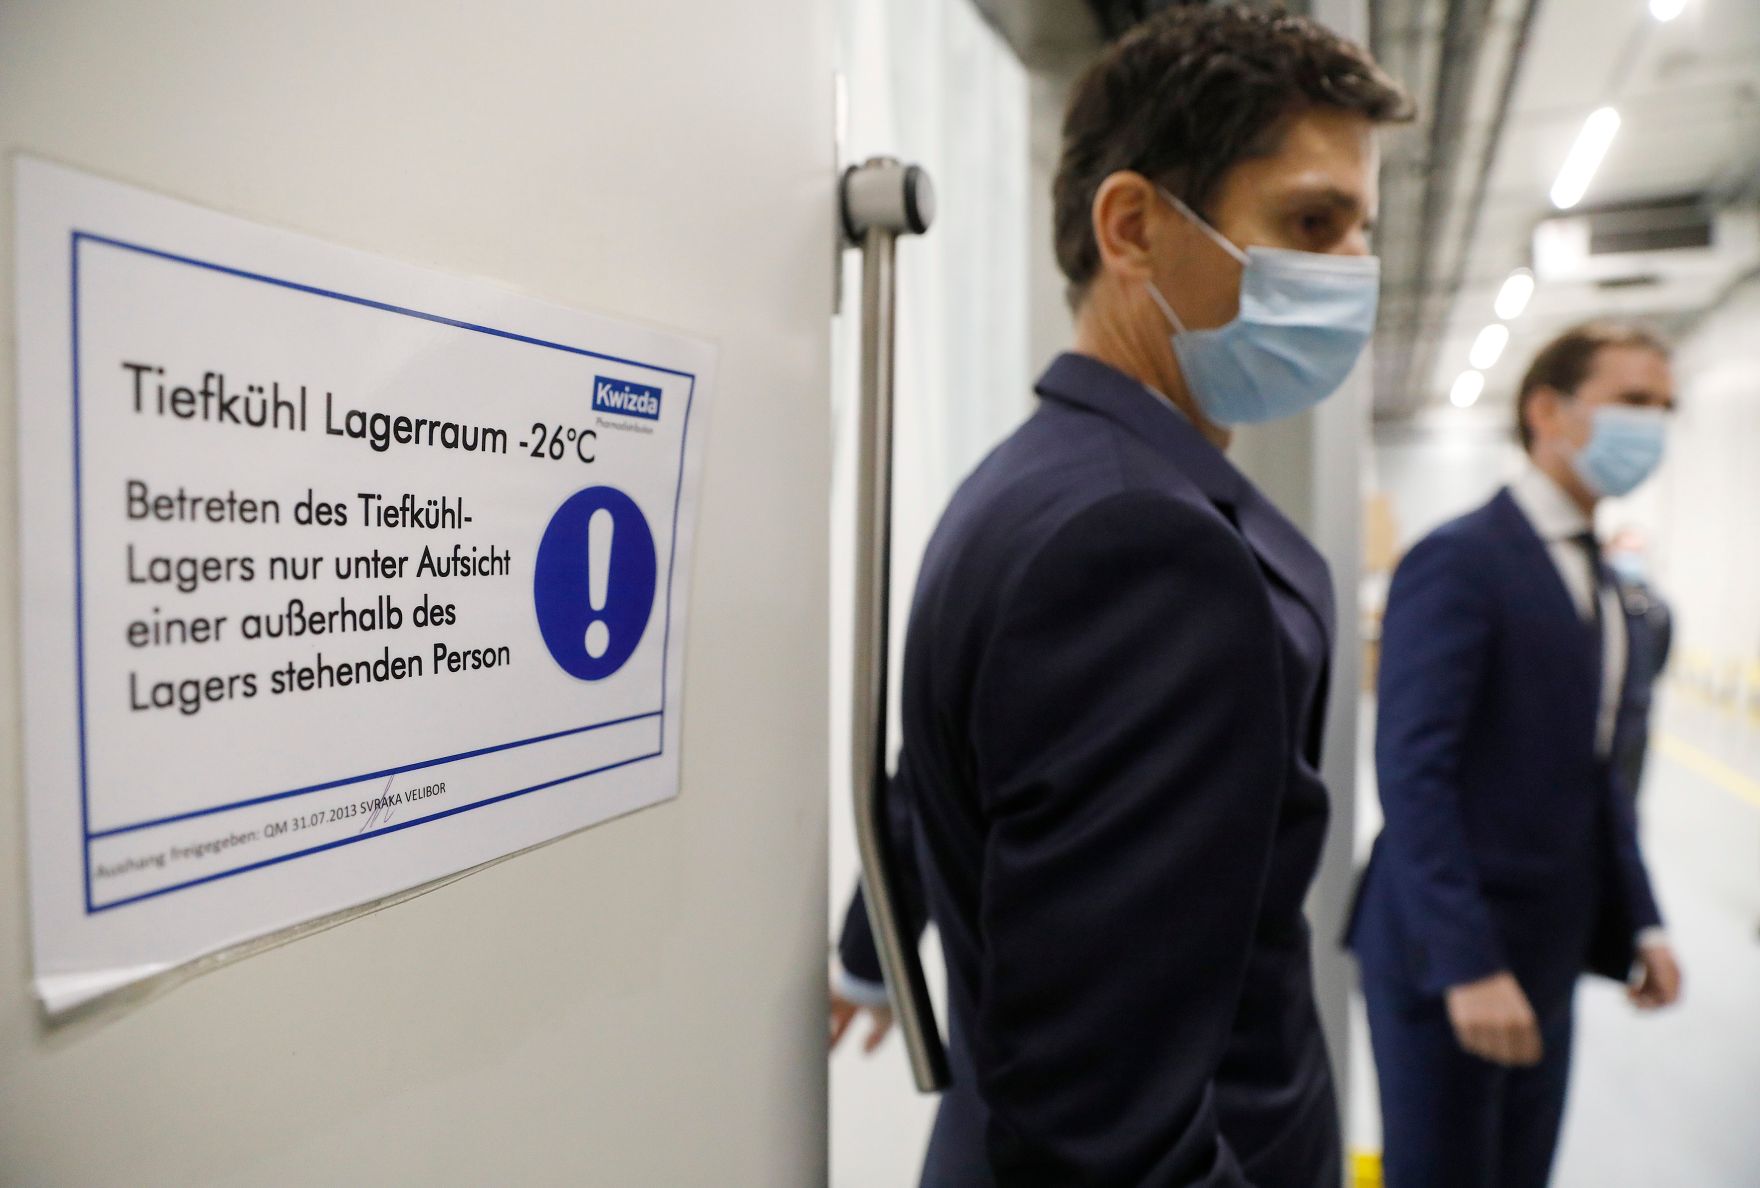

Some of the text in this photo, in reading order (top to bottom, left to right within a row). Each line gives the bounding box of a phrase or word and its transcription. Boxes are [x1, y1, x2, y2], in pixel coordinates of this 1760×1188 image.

[121, 361, 597, 464] Tiefkühl Lagerraum -26°C
[596, 382, 659, 415] Kwizda
[125, 479, 473, 530] Betreten des Tiefkühl-
[126, 543, 511, 595] Lagers nur unter Aufsicht
[126, 593, 457, 649] einer außerhalb des
[129, 642, 511, 717] Lagers stehenden Person
[264, 820, 289, 839] QM
[291, 804, 358, 832] 31.07.2013
[360, 793, 403, 815] SVRAKA
[404, 782, 447, 803] VELIBOR
